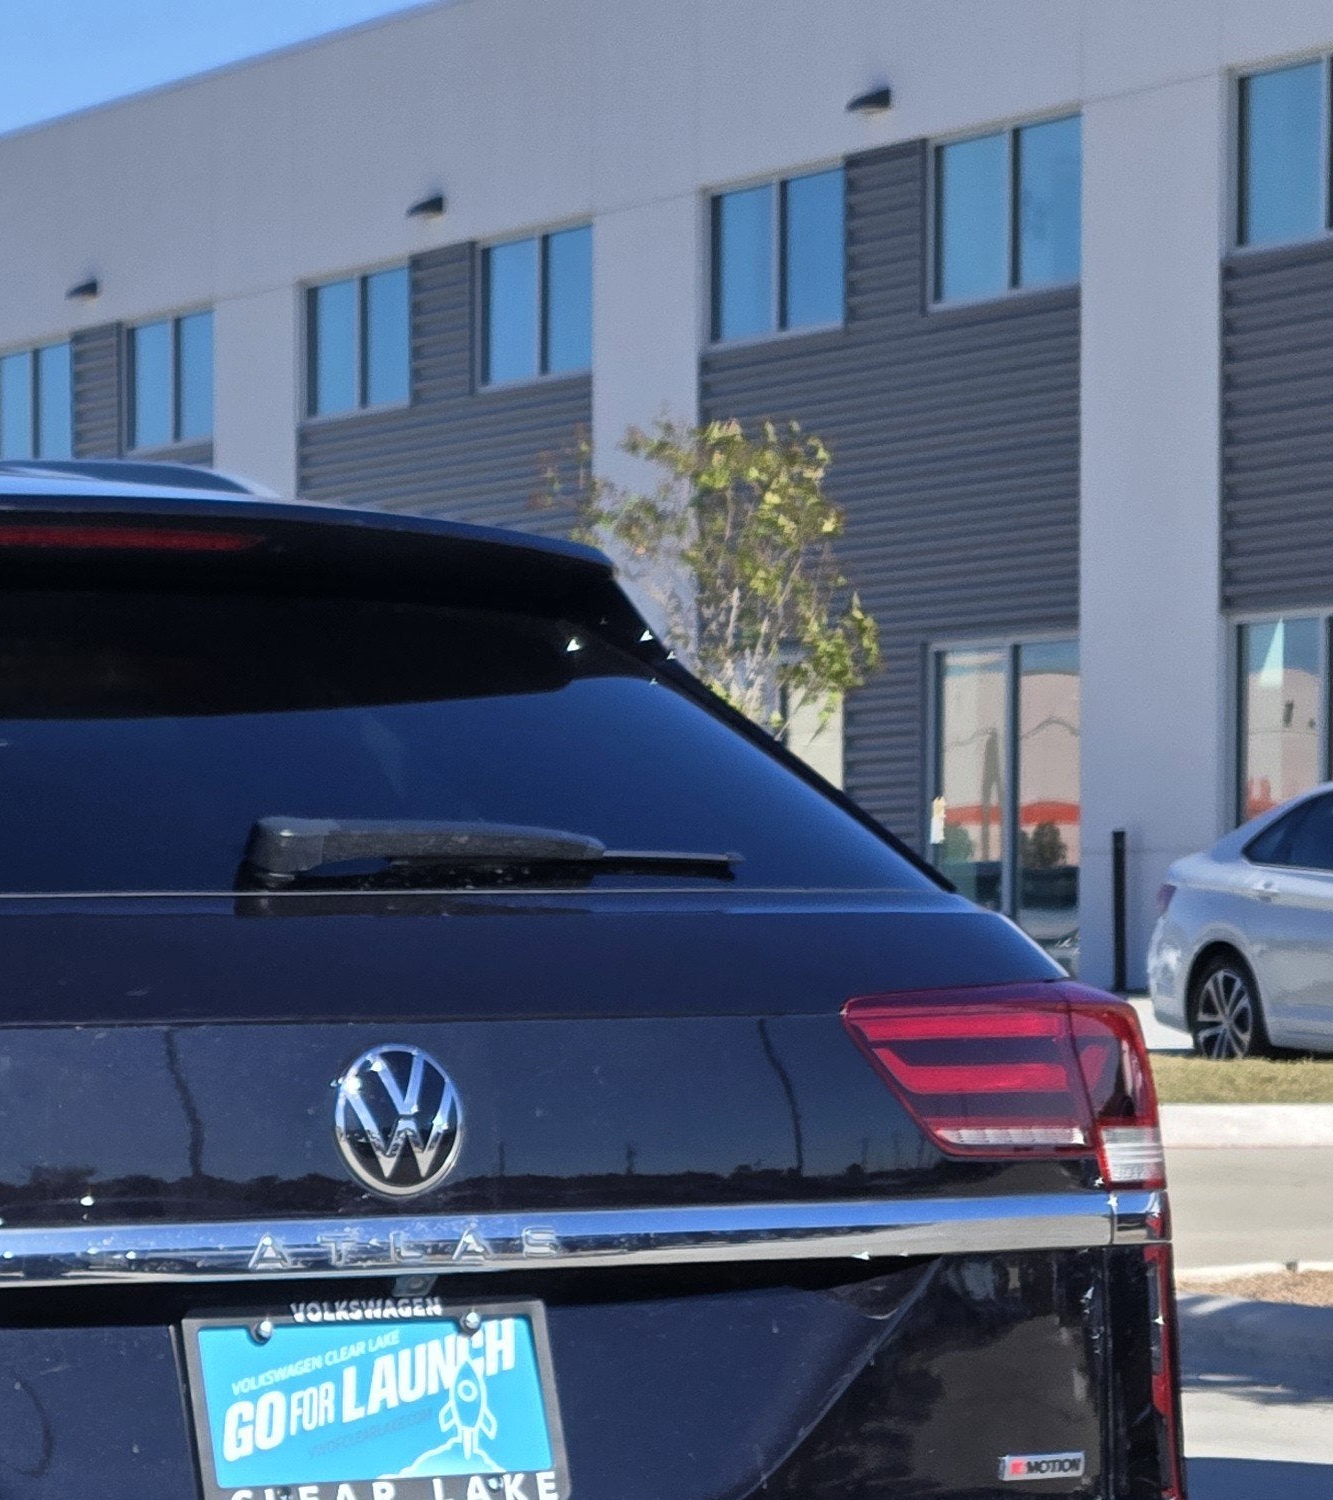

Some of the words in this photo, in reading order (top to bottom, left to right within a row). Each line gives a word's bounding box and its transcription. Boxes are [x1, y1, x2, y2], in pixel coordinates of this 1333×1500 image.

[248, 1225, 559, 1270] ATLAS
[290, 1297, 443, 1322] VOLKSWAGEN
[223, 1390, 287, 1462] GO
[289, 1381, 336, 1436] FOR
[342, 1318, 516, 1424] LAUNCH
[232, 1355, 324, 1396] VOLKSWAGEN
[324, 1341, 366, 1367] CLEAR
[368, 1329, 401, 1352] LAKE
